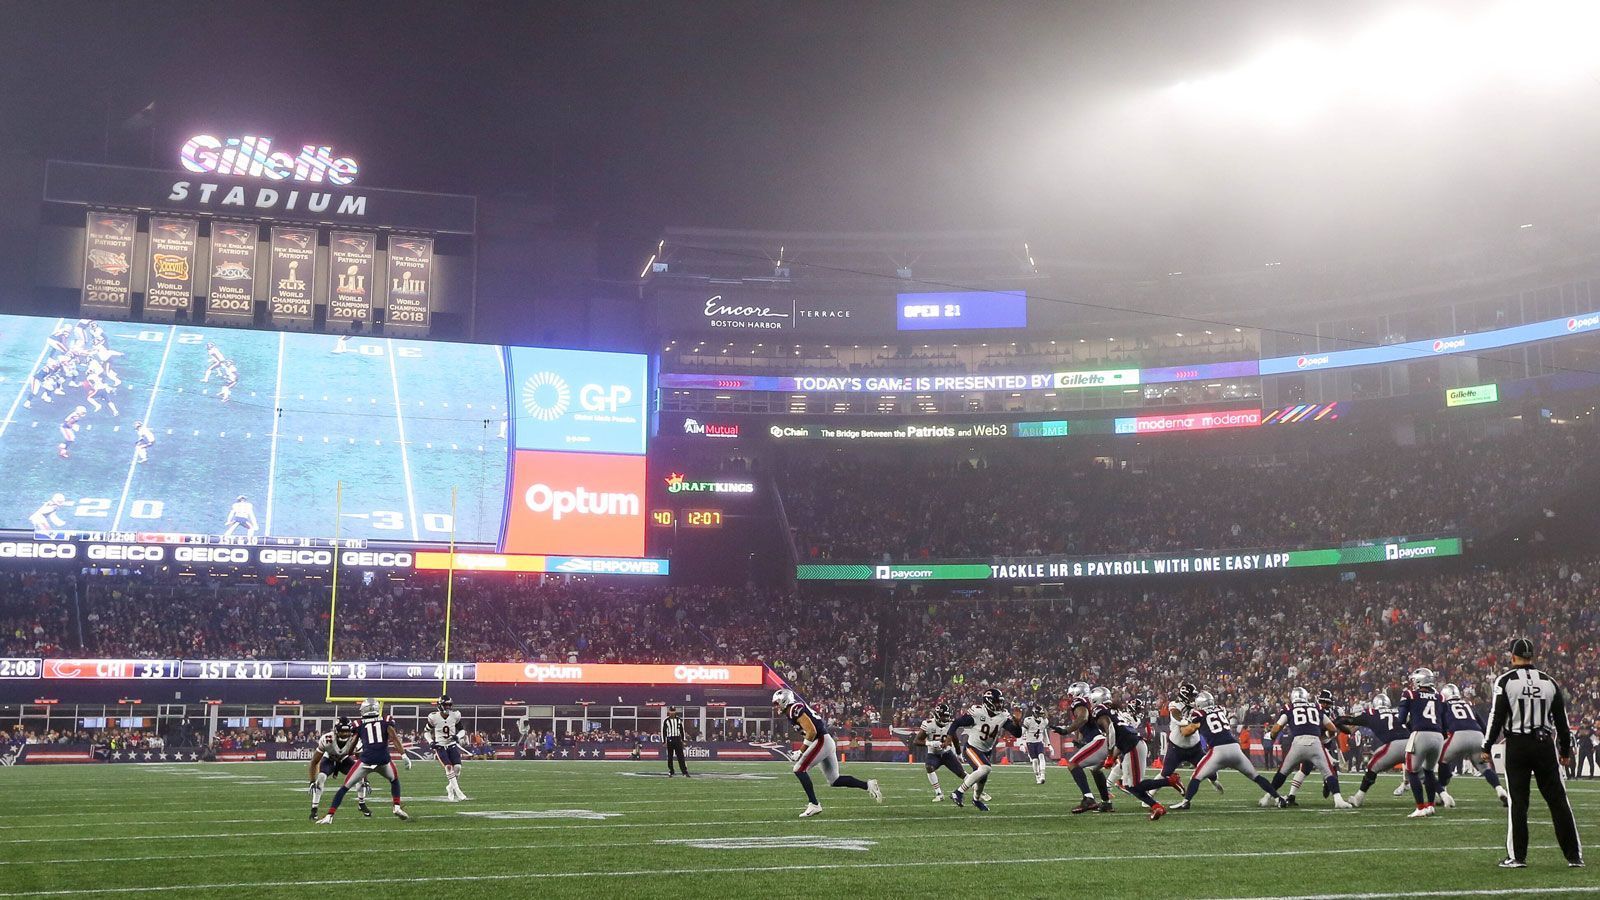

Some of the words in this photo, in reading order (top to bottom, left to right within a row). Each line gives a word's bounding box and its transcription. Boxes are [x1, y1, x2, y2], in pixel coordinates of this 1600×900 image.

[180, 134, 359, 186] Gillette
[168, 181, 367, 216] STADIUM
[278, 252, 309, 260] PATRIOTS
[337, 256, 367, 264] PATRIOTS
[87, 284, 127, 293] CHAMPIONS
[157, 282, 183, 290] WORLD
[278, 282, 306, 290] XLIX
[88, 292, 125, 303] 2001
[149, 289, 190, 297] CHAMPIONS
[211, 292, 250, 300] CHAMPIONS
[338, 294, 363, 302] WORLD
[149, 296, 188, 307] 2003
[211, 300, 250, 310] 2004
[272, 296, 310, 304] CHAMPIONS
[331, 300, 369, 309] CHAMPIONS
[396, 298, 420, 306] WORLD
[704, 295, 789, 317] Encore
[274, 304, 308, 314] 2014
[333, 307, 367, 318] 2016
[389, 304, 426, 312] CHAMPIONS
[800, 310, 851, 318] TERRACE
[944, 304, 961, 317] 21
[392, 311, 424, 322] 2018
[1577, 315, 1599, 328] pepsi
[711, 320, 745, 328] BOSTON
[747, 321, 782, 329] HARBOR
[1442, 338, 1465, 350] pepsi
[1307, 356, 1329, 367] pepsi
[793, 377, 862, 391] TODAY'S
[866, 377, 913, 391] GAME
[916, 377, 931, 390] IS
[935, 374, 1028, 390] PRESENTED
[1031, 374, 1052, 388] BY
[1060, 374, 1105, 386] Gillette
[1450, 389, 1477, 399] Gillette
[1138, 417, 1193, 430] moderna
[1202, 413, 1258, 427] moderna
[705, 424, 739, 435] Mutual
[784, 427, 809, 437] Chain
[821, 429, 835, 438] The
[836, 429, 860, 439] Bridge
[861, 429, 893, 438] Between
[893, 429, 906, 438] the
[907, 425, 955, 438] Patriots
[958, 429, 972, 437] and
[973, 424, 1008, 437] Web3
[668, 481, 754, 493] DRAFTKINGS
[524, 484, 640, 521] Optum
[653, 511, 671, 525] 40
[688, 511, 720, 525] 12:07
[0, 542, 77, 559] GEICO
[345, 539, 361, 549] 4TH
[88, 544, 164, 561] GEICO
[174, 545, 249, 563] GEICO
[259, 548, 332, 565] GEICO
[1398, 545, 1437, 559] paycom
[342, 551, 413, 567] GEICO
[991, 563, 1045, 578] TACKLE
[1050, 562, 1069, 577] HR
[1073, 562, 1083, 577] &
[1087, 560, 1149, 576] PAYROLL
[1153, 558, 1189, 574] WITH
[1194, 557, 1221, 572] ONE
[1225, 554, 1260, 570] EASY
[1264, 553, 1290, 568] APP
[592, 558, 659, 574] EMPOWER
[890, 570, 933, 579] paycom
[0, 660, 36, 676] 2:08
[96, 661, 126, 677] CHI
[141, 662, 164, 678] 33
[199, 663, 231, 679] 1ST
[235, 663, 248, 679] &
[253, 663, 273, 679] 10
[311, 665, 329, 676] BALL
[329, 665, 341, 677] ON
[348, 663, 367, 679] 18
[407, 666, 422, 677] QTR
[434, 664, 464, 680] 4TH
[524, 663, 582, 681] Optum
[674, 665, 729, 683] Optum
[1522, 686, 1542, 698] 42
[1292, 707, 1321, 726] 60
[1422, 700, 1437, 725] 4
[1451, 703, 1476, 720] 61
[1206, 711, 1231, 734] 69
[364, 721, 383, 744] 11
[442, 725, 450, 740] 9
[979, 723, 1000, 743] 94
[1033, 728, 1041, 740] 4
[276, 746, 315, 759] VOLUNTEER
